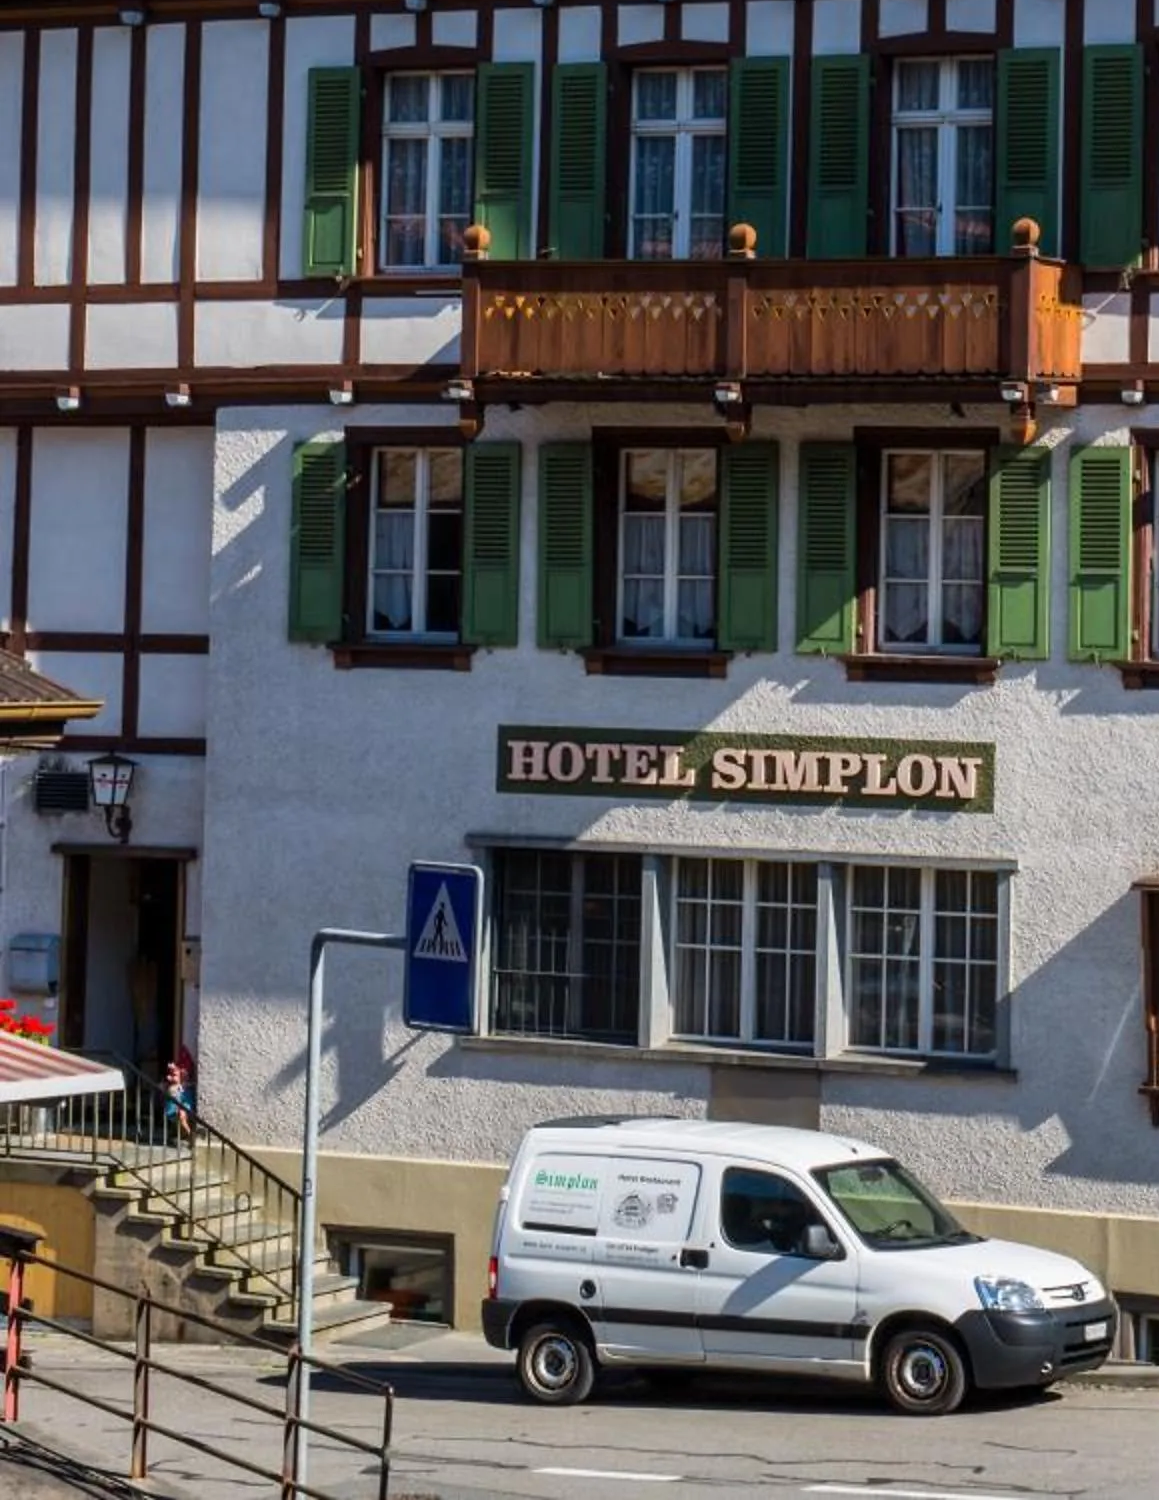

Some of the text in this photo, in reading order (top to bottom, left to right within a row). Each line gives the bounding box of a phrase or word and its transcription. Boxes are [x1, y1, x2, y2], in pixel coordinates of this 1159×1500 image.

[506, 739, 983, 800] HOTEL SIMPLON
[535, 1169, 599, 1190] Simplon
